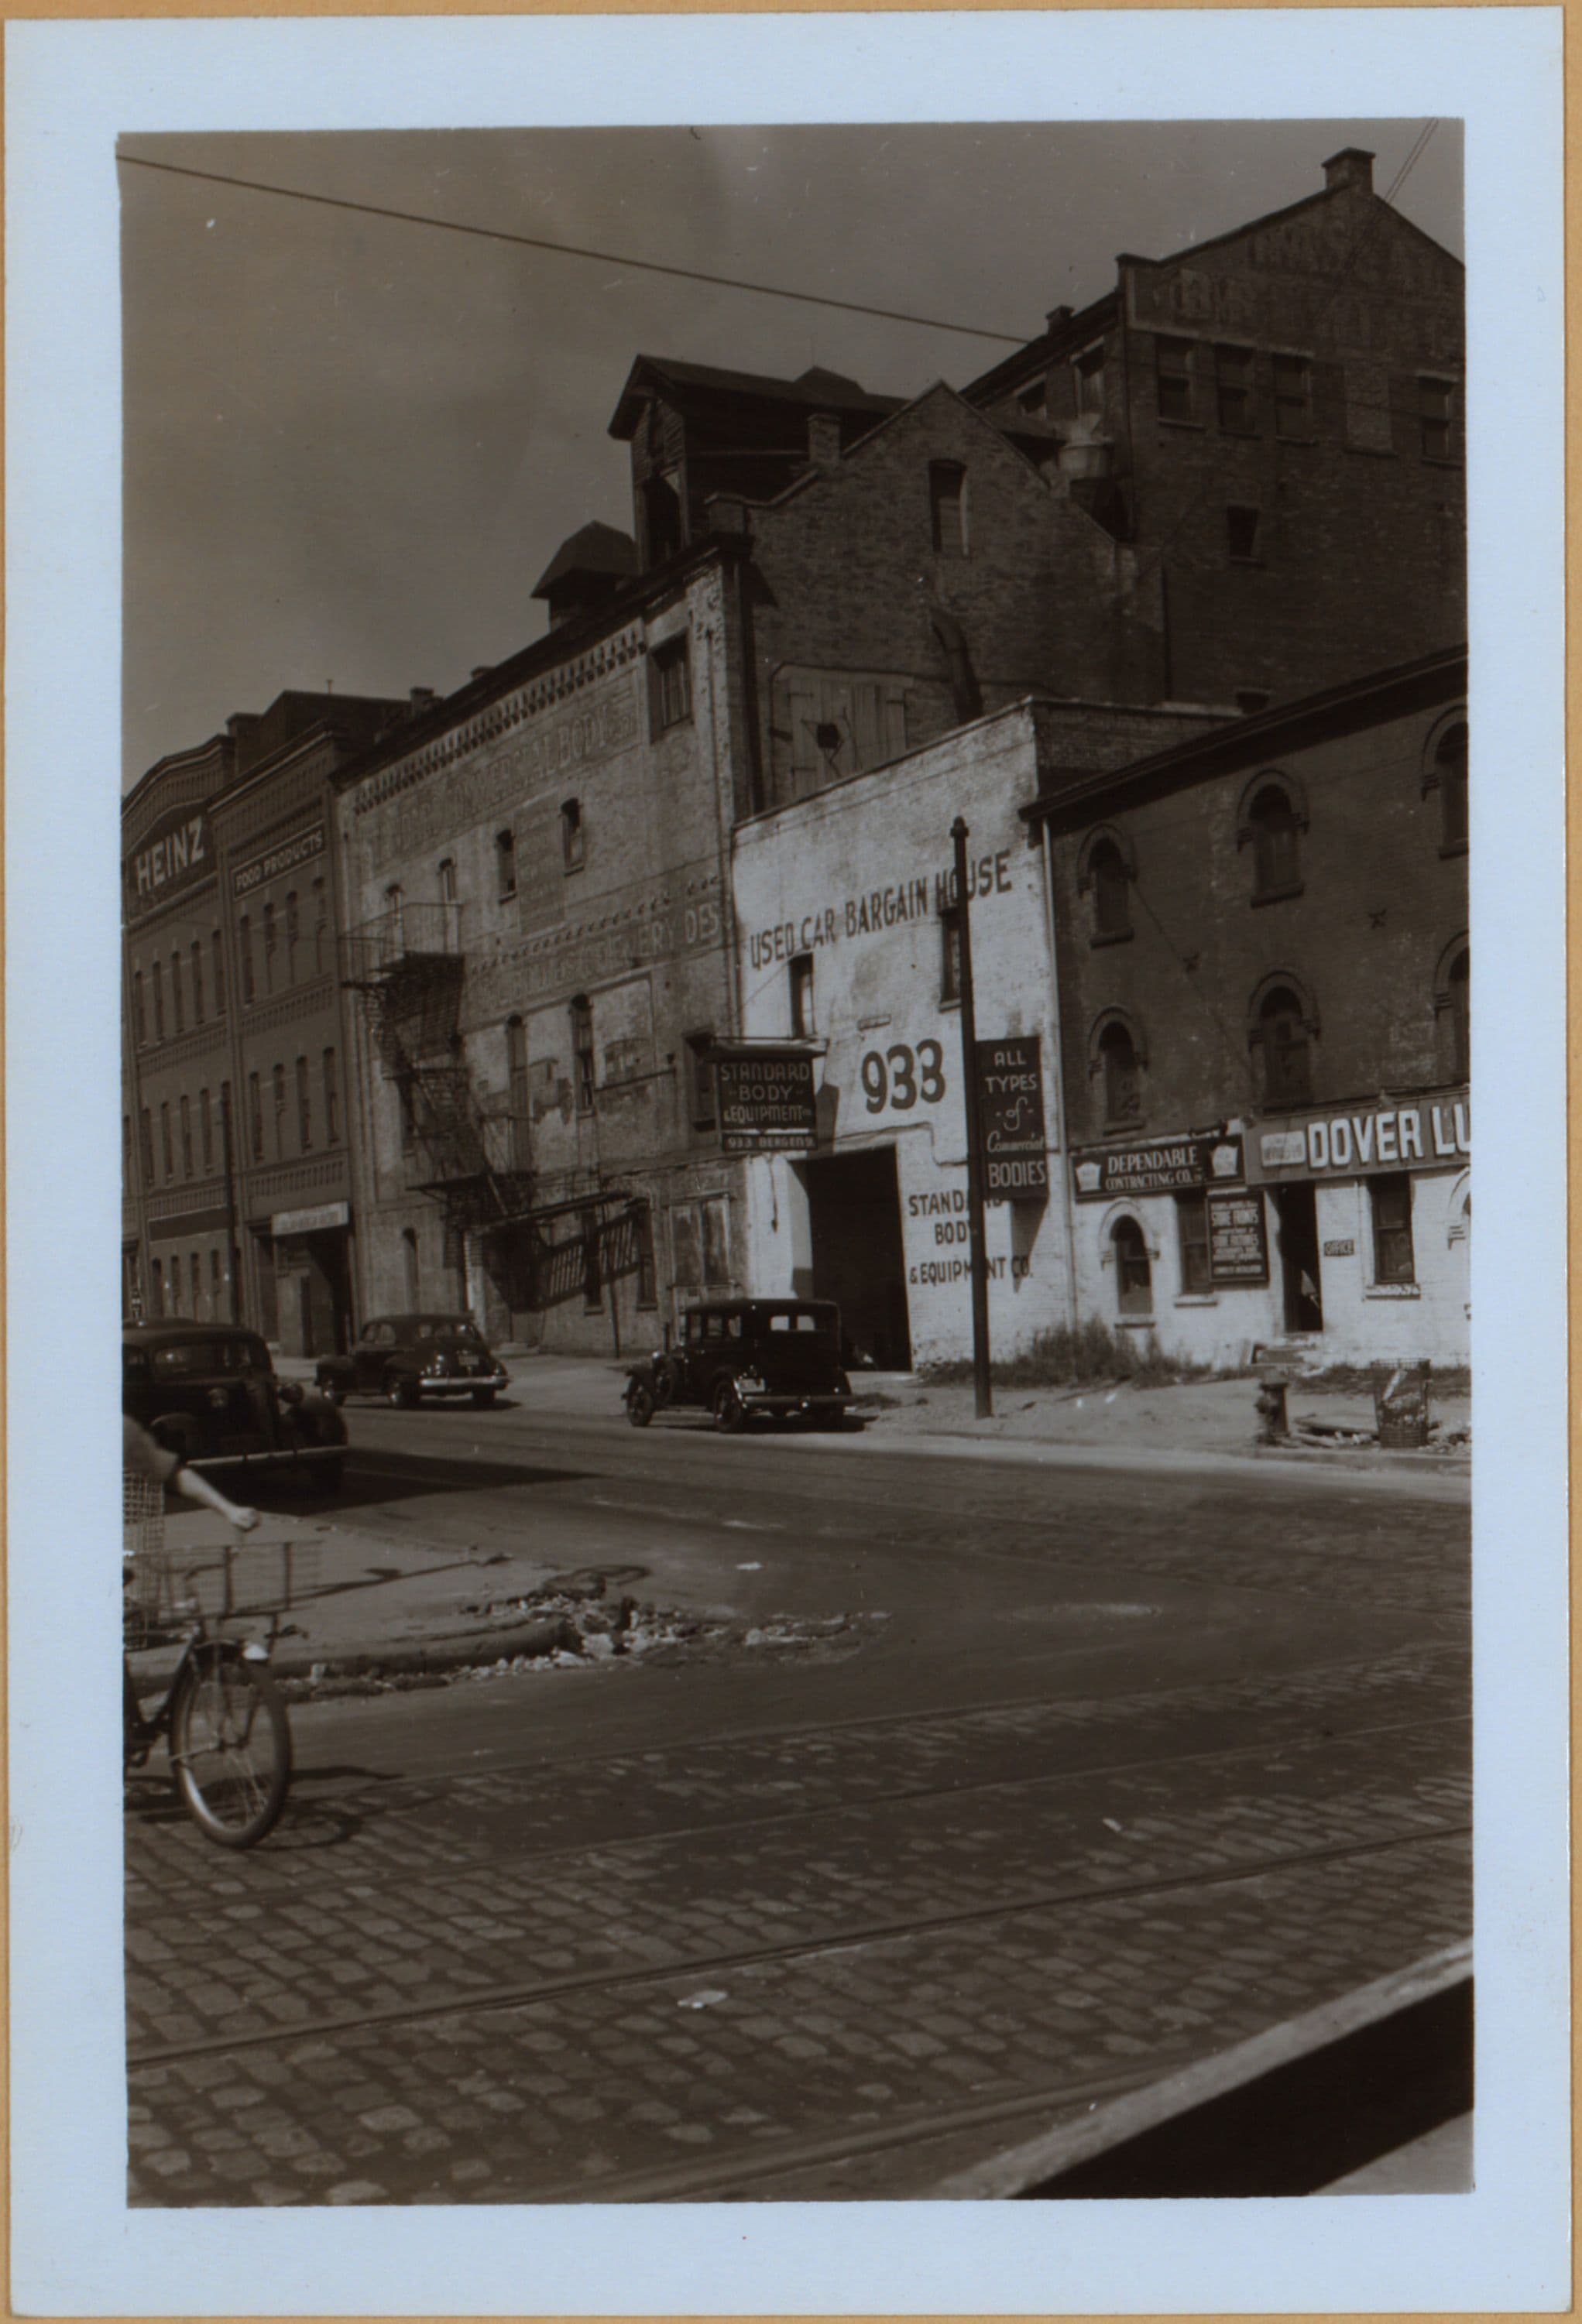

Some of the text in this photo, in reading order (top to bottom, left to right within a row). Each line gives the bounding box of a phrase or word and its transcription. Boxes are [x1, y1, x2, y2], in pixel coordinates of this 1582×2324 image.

[136, 815, 204, 896] HEINZ
[235, 829, 322, 890] FOOD PRODUCTS
[751, 921, 794, 970] USED
[801, 908, 836, 950] CAR
[846, 876, 928, 937] BARGAIN
[720, 1061, 810, 1081] STANDARD
[994, 1050, 1027, 1066] ALL
[861, 1038, 945, 1114] 933
[985, 1073, 1038, 1094] TYPES
[739, 1085, 794, 1101] BODY
[1003, 1096, 1028, 1131] of
[728, 1136, 753, 1149] 933
[987, 1129, 1045, 1153] Commercial
[1308, 1109, 1424, 1168] DOVER
[1107, 1145, 1198, 1175] DEPENDABLE
[987, 1161, 1046, 1189] BODIES
[1105, 1172, 1174, 1191] CONTRACTING
[1325, 1240, 1352, 1255] OFFICE
